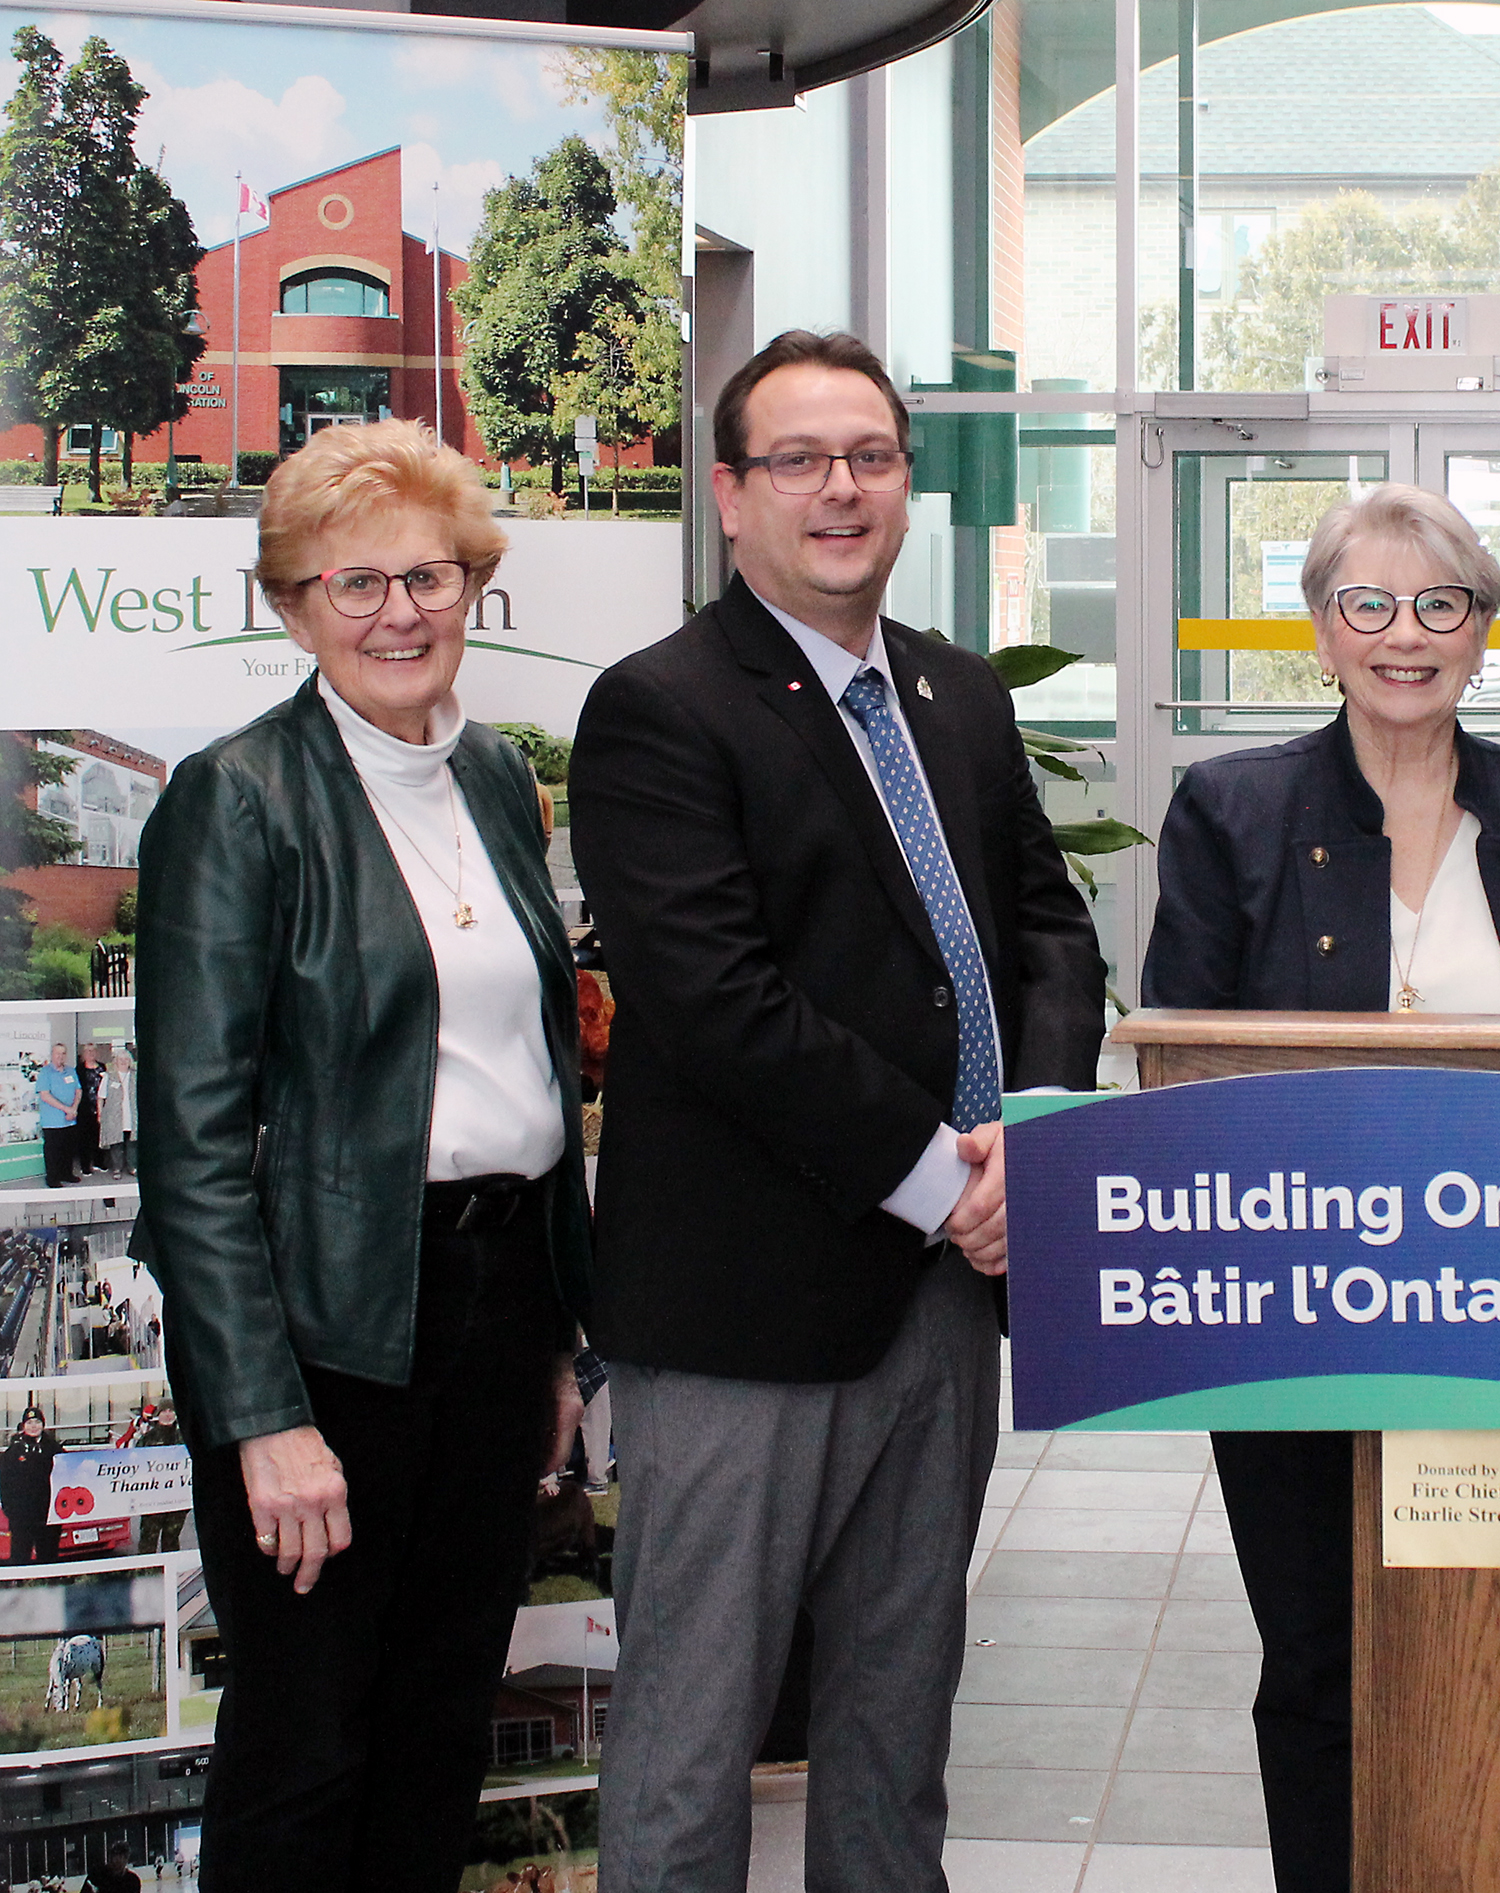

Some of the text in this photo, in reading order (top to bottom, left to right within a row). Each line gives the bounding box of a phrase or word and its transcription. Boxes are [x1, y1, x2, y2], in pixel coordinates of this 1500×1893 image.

[1380, 303, 1455, 349] EXIT
[198, 371, 215, 381] OF
[26, 567, 212, 633] West
[241, 657, 289, 677] Your
[1096, 1172, 1402, 1246] Building
[1099, 1266, 1274, 1325] Bâtir
[97, 1462, 139, 1479] Enjoy
[147, 1460, 181, 1473] Your
[1417, 1463, 1499, 1479] Donated by
[110, 1478, 159, 1493] Thank
[164, 1480, 173, 1489] a
[1412, 1483, 1449, 1498] Fire
[1394, 1506, 1463, 1522] Charlie
